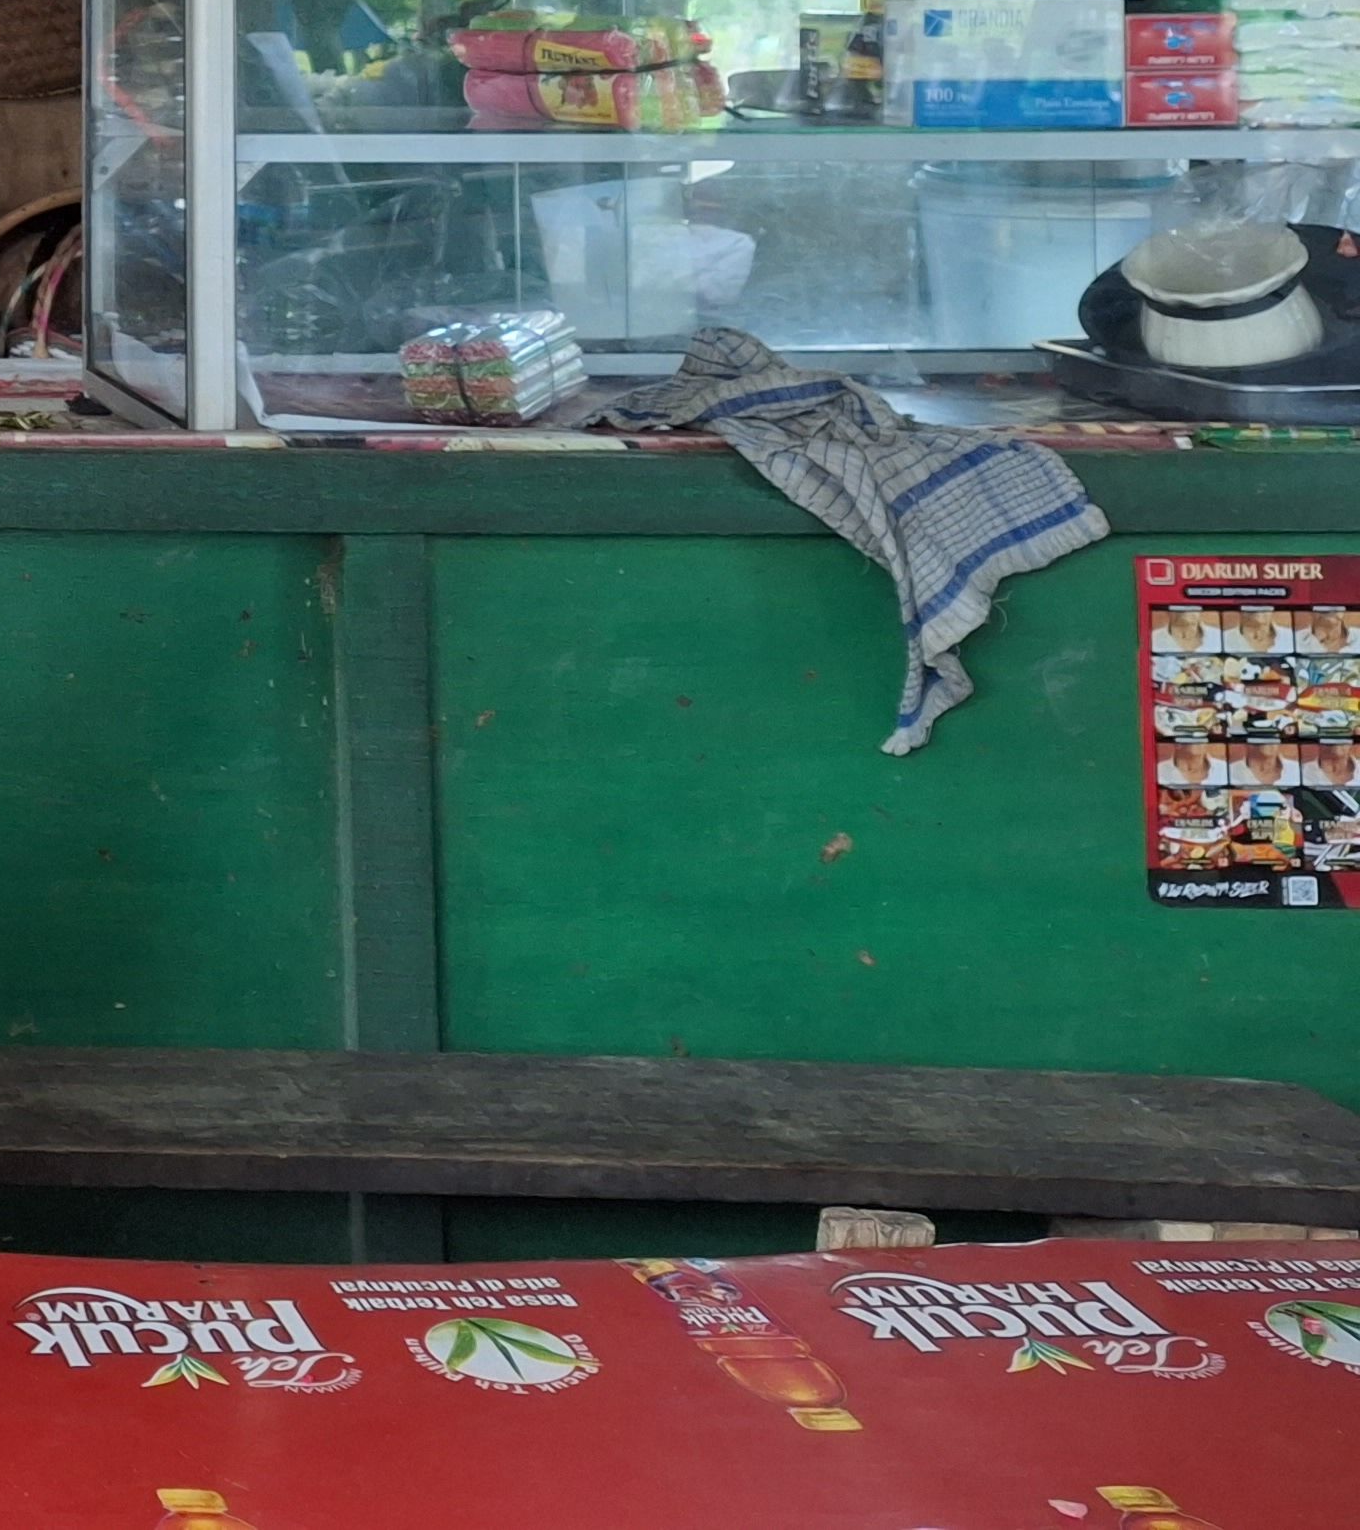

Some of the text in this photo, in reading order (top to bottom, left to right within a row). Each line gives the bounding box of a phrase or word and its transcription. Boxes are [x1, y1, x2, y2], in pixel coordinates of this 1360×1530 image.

[924, 88, 954, 103] 100
[1181, 563, 1324, 580] DJARUM SUPER
[1282, 1259, 1318, 1275] di
[329, 1277, 562, 1295] ada di Pucuknya!
[1156, 1277, 1276, 1294] Terbaik
[1268, 1277, 1330, 1293] Teh
[341, 1293, 579, 1312] Rasa Teh Terbaik
[847, 1282, 1079, 1307] HARUM
[36, 1299, 255, 1322] HARUM
[1083, 1335, 1208, 1372] Teh
[231, 1352, 356, 1389] Teh
[537, 1362, 600, 1394] Pucuk
[283, 1368, 364, 1395] MINUMAN
[474, 1378, 530, 1395] Teh
